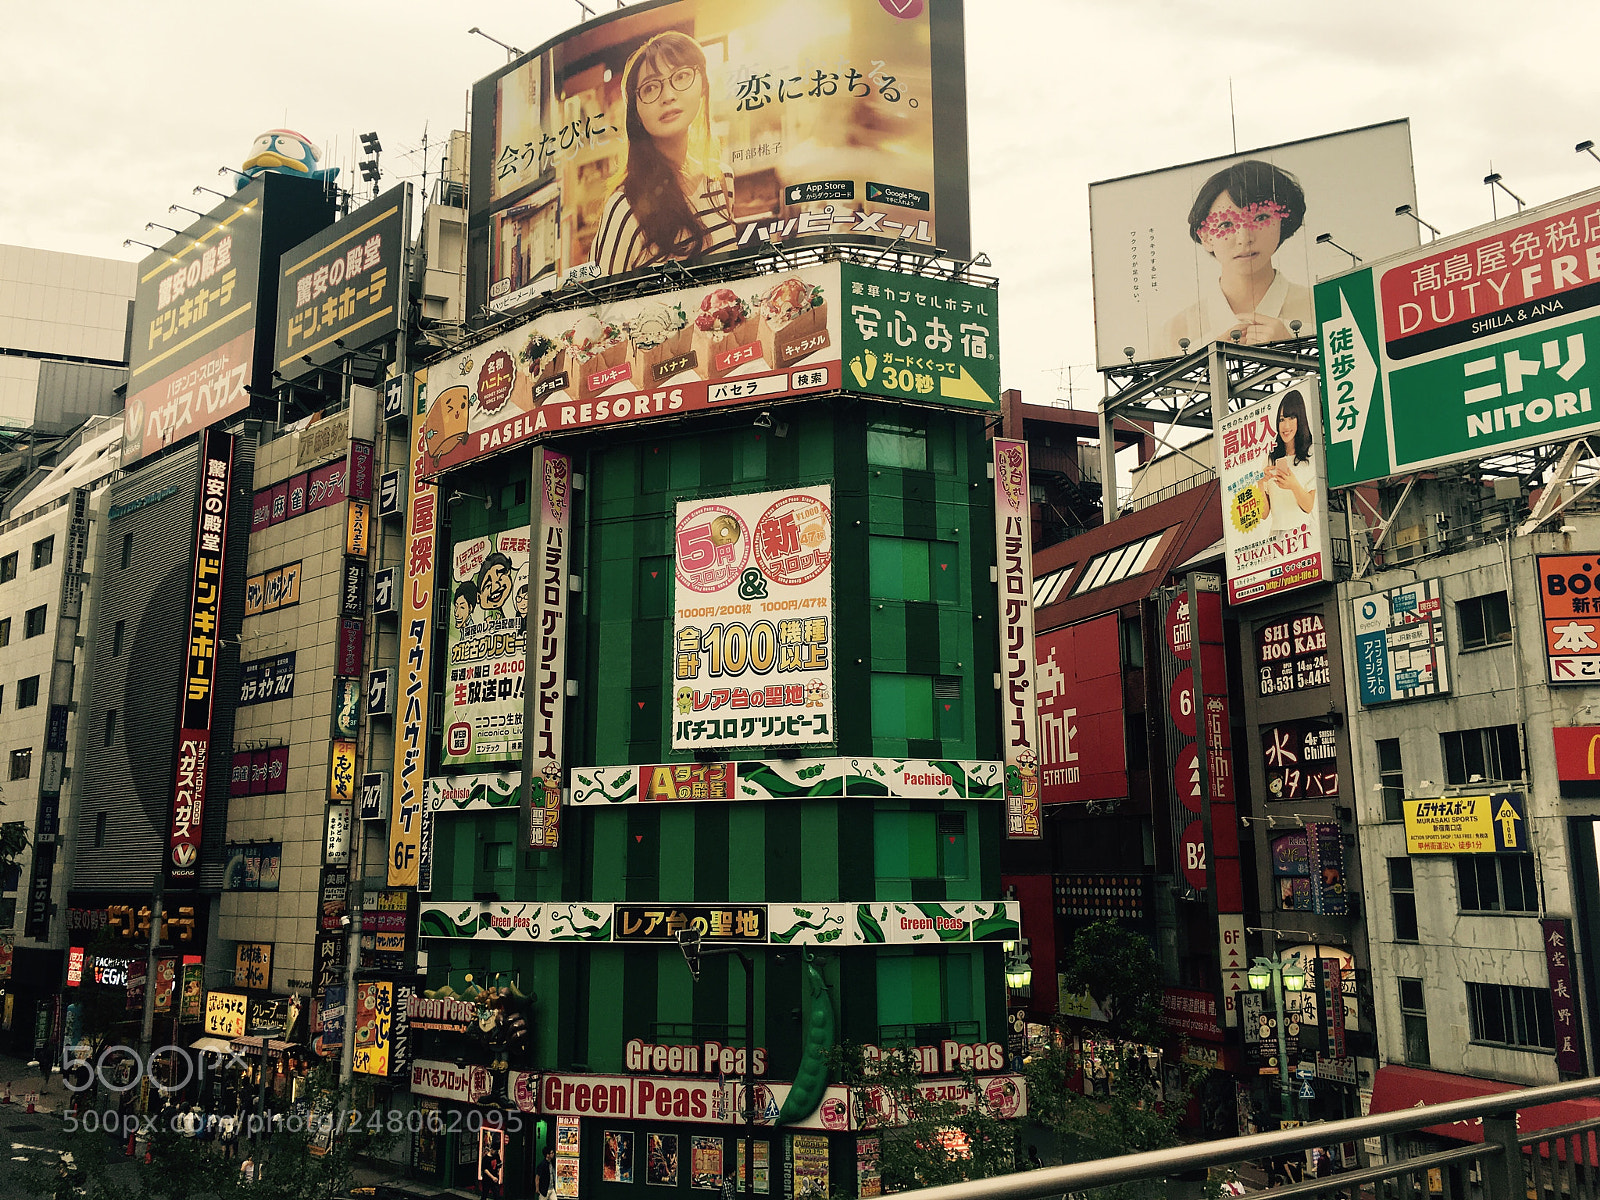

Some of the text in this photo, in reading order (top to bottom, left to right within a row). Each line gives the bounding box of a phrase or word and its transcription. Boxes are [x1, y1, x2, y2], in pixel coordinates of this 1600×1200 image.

[736, 68, 919, 111] 恋におちる。
[497, 113, 619, 181] 会うたびに、
[806, 182, 846, 193] App Store
[885, 188, 922, 203] Google Play
[738, 204, 932, 245] ハッピーメール
[296, 233, 382, 309] 驚安の殿堂
[851, 281, 989, 316] 豪華カプセルホテル
[1398, 272, 1512, 334] DUTY
[1471, 299, 1564, 334] SHILLA & ANA
[785, 334, 826, 356] キャラメル
[851, 304, 990, 359] 安心お宿
[659, 357, 688, 375] バナナ
[723, 347, 753, 365] イチゴ
[882, 353, 956, 373] ガードくぐって
[1464, 332, 1586, 405] ニトリ
[534, 377, 564, 397] 生チョコ
[592, 368, 627, 386] ミルキー
[715, 381, 758, 399] パセラ
[797, 372, 822, 386] 検索
[882, 366, 935, 394] 30秒
[1329, 327, 1360, 432] 徒歩2分
[479, 388, 683, 451] PASELA RESORTS
[1466, 387, 1592, 438] NITORI
[1222, 414, 1277, 459] 高収入
[1224, 440, 1277, 470] 求人情報サイト
[201, 458, 226, 552] 驚安の殿堂
[761, 510, 801, 560] 新
[769, 548, 828, 577] スロット
[738, 567, 769, 601] &
[677, 597, 828, 619] 1000円/200枚 1000円/47枚
[1552, 621, 1598, 653] 本
[451, 664, 490, 682] 毎週水曜日
[493, 659, 525, 676] 24:00
[1363, 641, 1376, 696] アイシティ
[1374, 639, 1386, 695] コンタクトの
[692, 682, 805, 712] レア台の聖地
[399, 618, 426, 834] タウンハウジング
[477, 729, 510, 738] niconico
[1265, 728, 1298, 767] 水
[903, 772, 953, 787] Pachislo
[1043, 765, 1080, 787] STATION
[441, 786, 470, 801] Pachislo
[1416, 800, 1476, 817] ムラサキスポーツ
[1452, 815, 1478, 823] SPORTS
[1500, 809, 1514, 818] GO!
[1433, 824, 1462, 832] 新宿南口店
[394, 841, 416, 870] 6F
[1417, 840, 1482, 850] 甲州街道沿い 徒歩1分
[491, 914, 531, 928] Green Peas
[622, 909, 760, 938] レア台の聖地
[900, 915, 964, 931] Green Peas
[1224, 930, 1240, 945] 6F
[406, 995, 474, 1023] Green Peas
[626, 1038, 768, 1077] Green Peas
[940, 1040, 1004, 1073] Peas
[413, 1066, 469, 1092] 選べるスロット
[545, 1076, 627, 1114] Green
[637, 1081, 708, 1118] Peas
